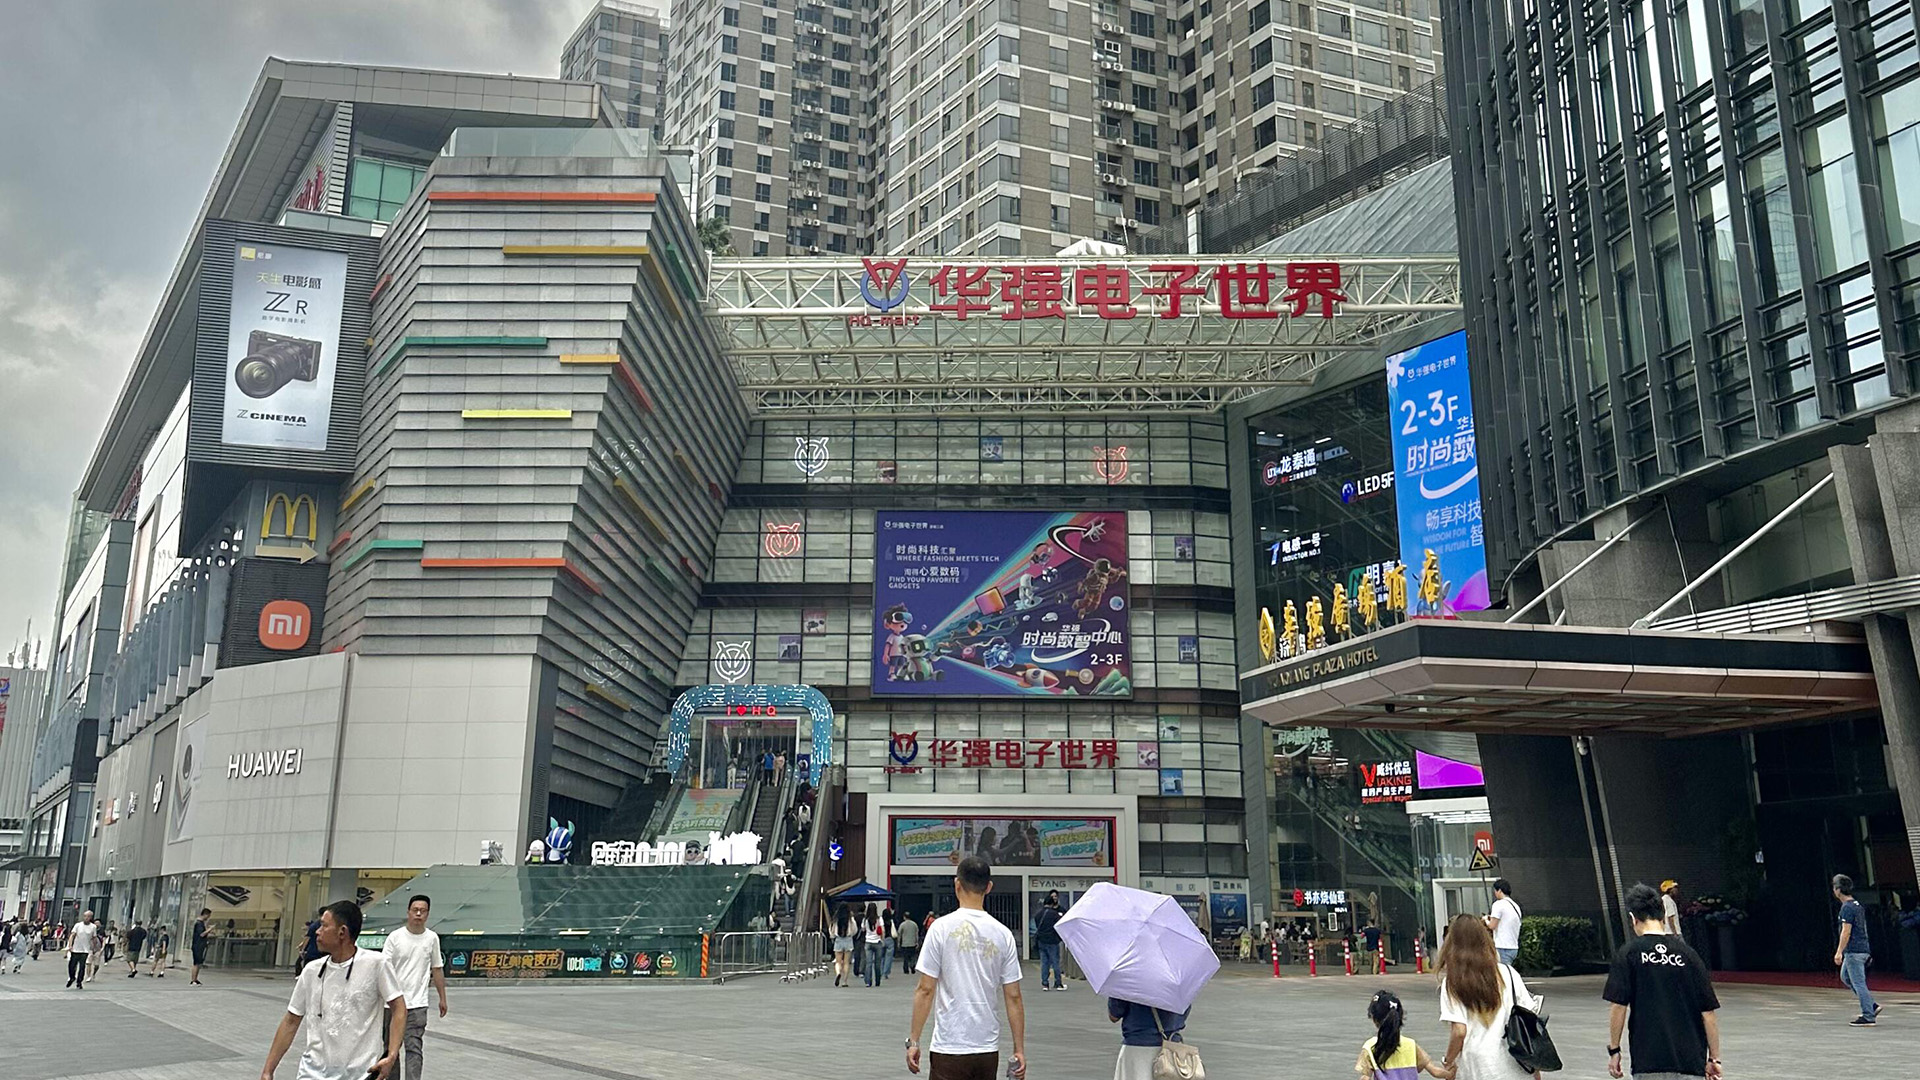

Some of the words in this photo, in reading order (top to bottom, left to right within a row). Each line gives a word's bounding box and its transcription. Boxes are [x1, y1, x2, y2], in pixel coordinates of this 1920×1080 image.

[256, 272, 322, 289] 天生电影感
[928, 263, 1348, 320] 华强电子世界
[250, 413, 307, 423] CINEMA
[1400, 389, 1458, 435] 2-3F
[1457, 414, 1474, 430] 华
[1280, 448, 1317, 475] 龙泰通
[1426, 499, 1481, 531] 畅享科技
[1282, 532, 1321, 553] 电感一号
[1282, 551, 1308, 562] INDUCTOR
[1021, 628, 1123, 648] 时尚数智中心
[1090, 654, 1122, 665] 2-3F
[1313, 655, 1345, 677] PLAZA
[1347, 646, 1379, 667] HOTEL
[928, 738, 1120, 768] 华强电子世界
[1312, 740, 1333, 755] 2-3F
[227, 748, 304, 779] HUAWEI
[1031, 879, 1066, 888] EYANG
